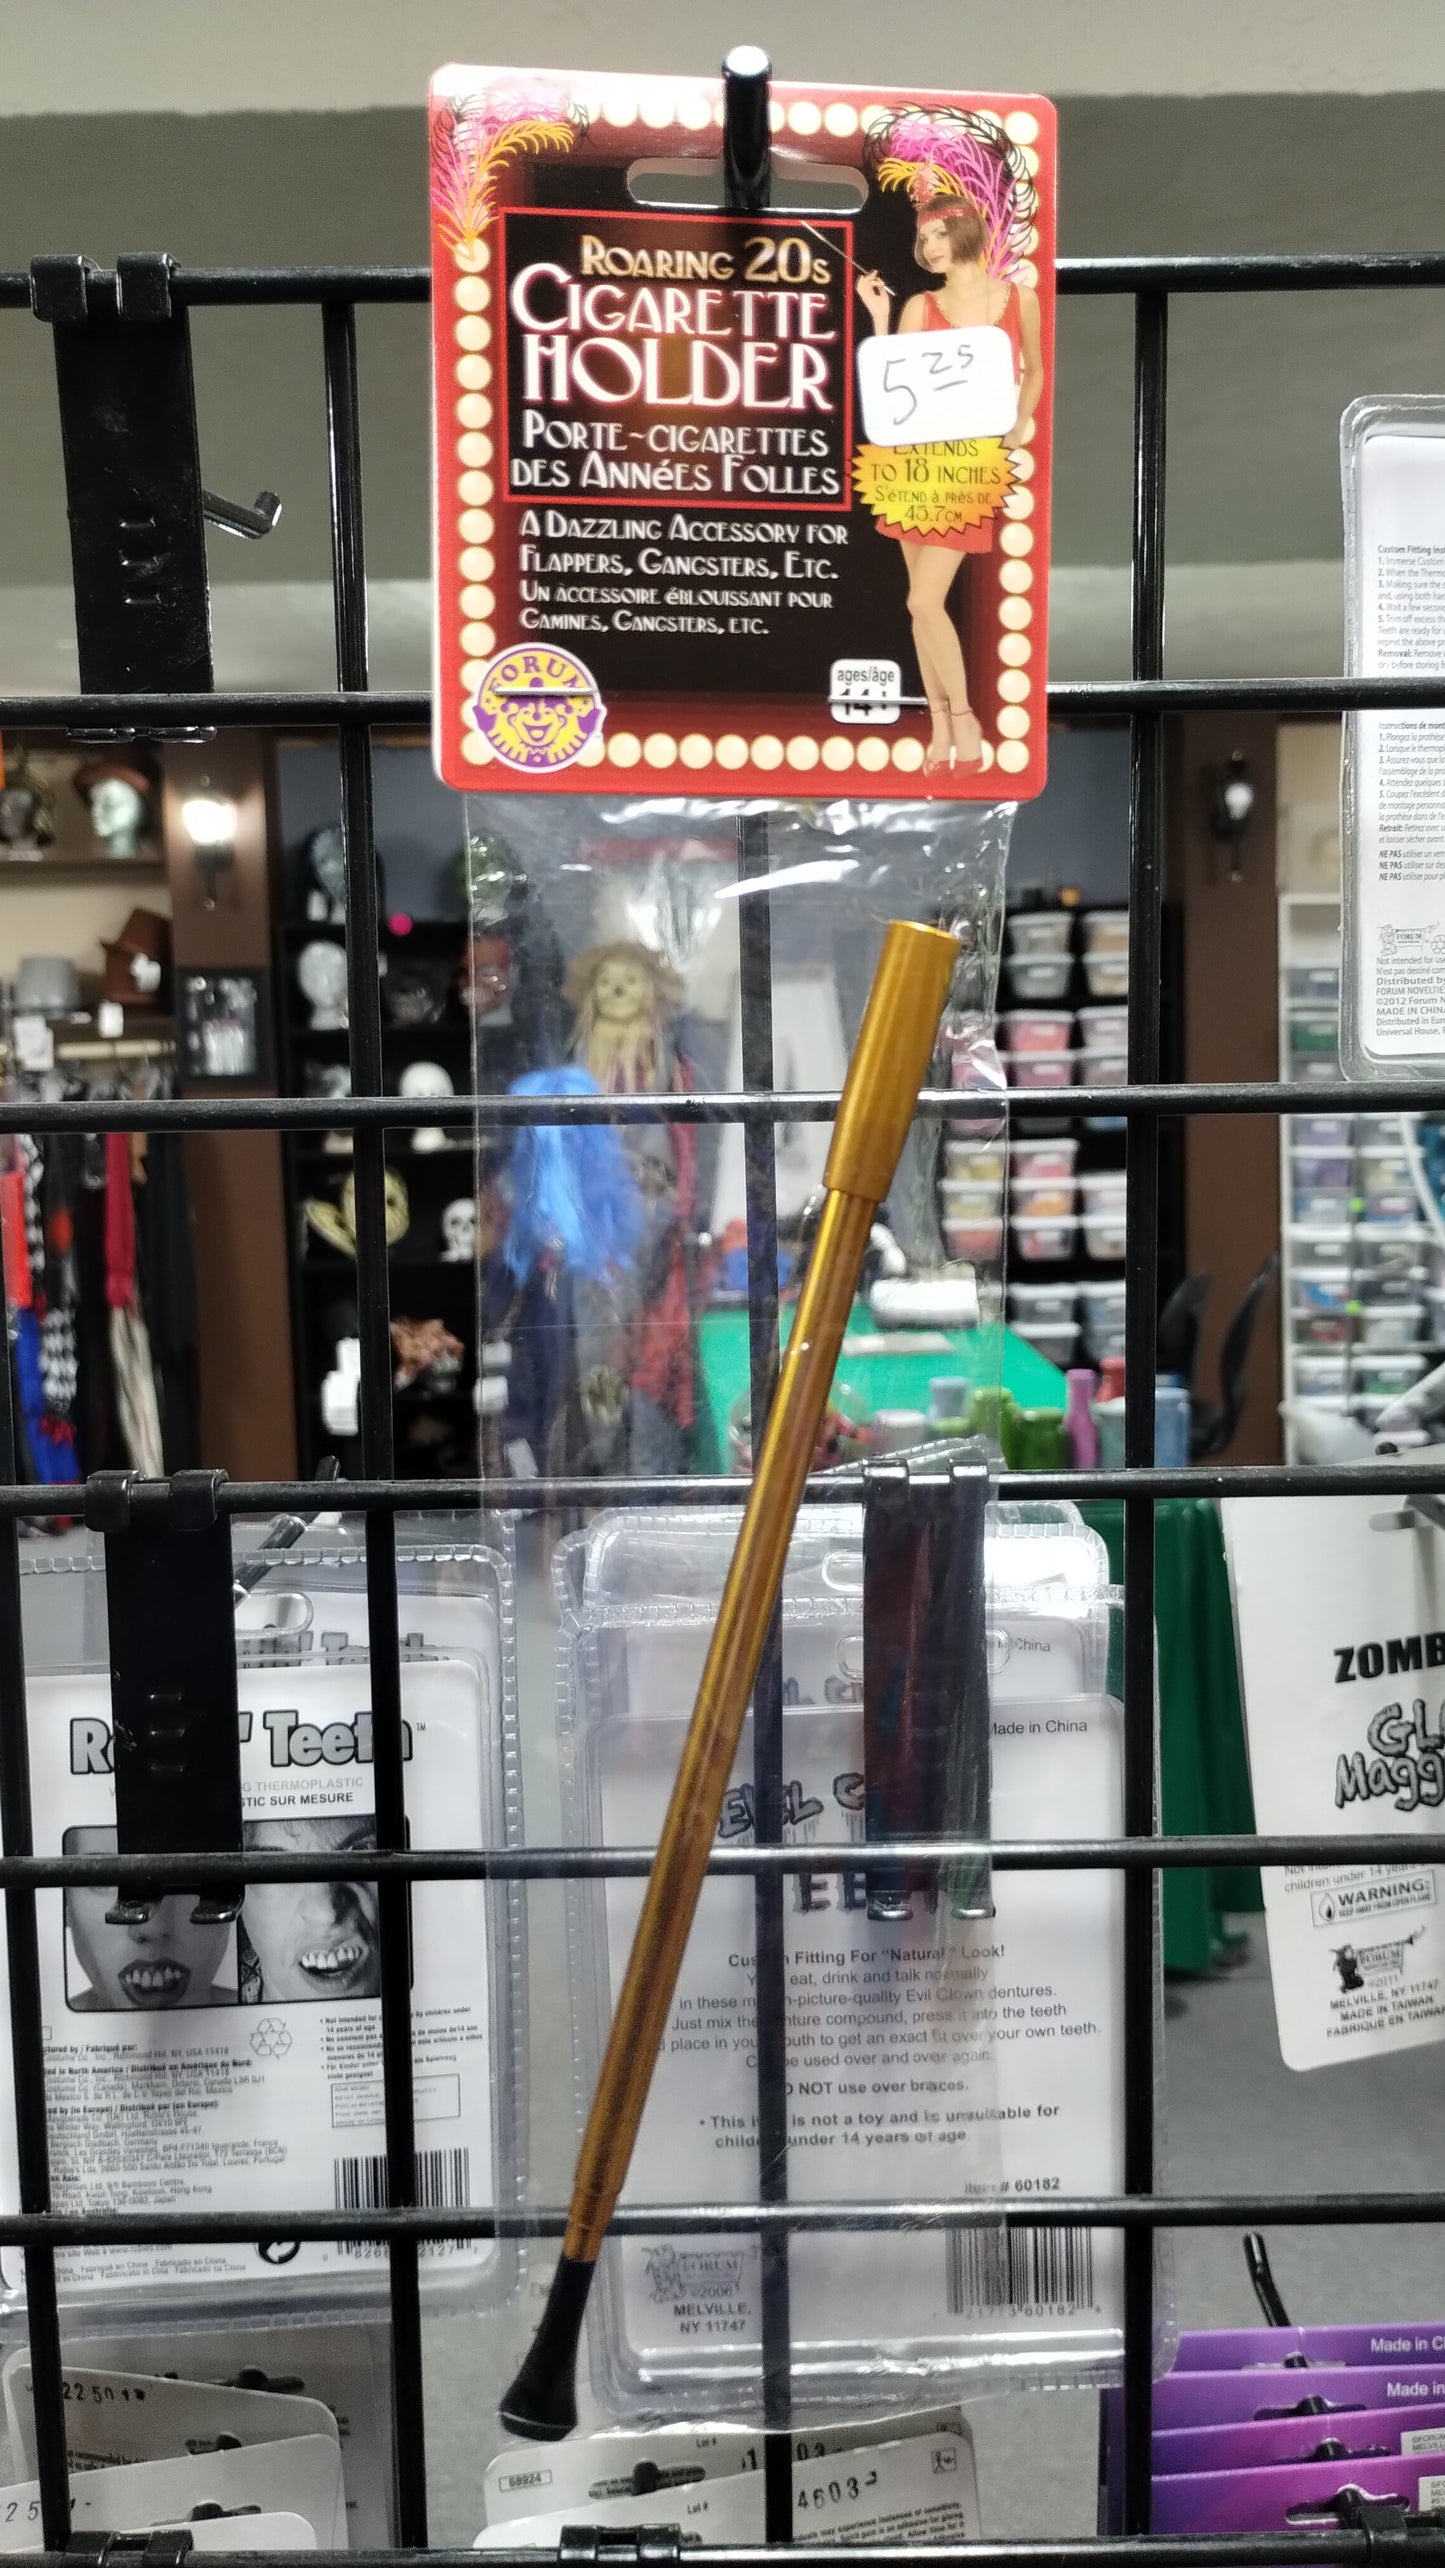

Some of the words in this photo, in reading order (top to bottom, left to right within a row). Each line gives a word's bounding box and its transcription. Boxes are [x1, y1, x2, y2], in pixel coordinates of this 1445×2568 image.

[510, 262, 837, 340] CIGARETTE
[522, 333, 834, 410] HOLDER
[871, 464, 897, 482] TO
[905, 458, 930, 483] 18
[938, 466, 1001, 484] INCHES
[519, 509, 541, 537] A
[1376, 977, 1433, 986] Distributed
[1376, 987, 1405, 996] FORUM
[1376, 1007, 1404, 1016] MADE
[1407, 1006, 1417, 1015] IN
[1029, 1720, 1042, 1734] in
[1045, 1719, 1088, 1733] China
[256, 1776, 364, 1793] THERMOPLASTIC
[270, 1794, 296, 1806] SUR
[300, 1791, 353, 1806] MESURE
[795, 1951, 845, 1965] Fitting
[850, 1950, 876, 1961] For
[962, 1944, 1005, 1959] Look!
[790, 1973, 817, 1986] eat,
[822, 1971, 858, 1983] drink
[863, 1970, 890, 1983] and
[895, 1968, 920, 1981] talk
[680, 1997, 692, 2009] in
[697, 1995, 737, 2008] these
[906, 1988, 931, 2001] Evil
[935, 1986, 983, 2000] Clown
[989, 1984, 1056, 1999] dentures.
[671, 2018, 701, 2030] Just
[706, 2017, 732, 2029] mix
[826, 2010, 908, 2026] compound,
[913, 2010, 953, 2025] press
[958, 2008, 968, 2019] it
[1002, 2006, 1025, 2018] the
[1030, 2003, 1067, 2017] teeth
[670, 2037, 710, 2052] place
[715, 2036, 727, 2048] in
[820, 2034, 834, 2046] to
[838, 2033, 861, 2049] get
[866, 2033, 885, 2045] an
[889, 2030, 928, 2043] exact
[932, 2027, 947, 2042] fit
[952, 2030, 982, 2041] over
[988, 2028, 1021, 2043] your
[1025, 2026, 1055, 2039] own
[1060, 2021, 1101, 2036] teeth.
[804, 2052, 839, 2066] used
[844, 2053, 876, 2065] over
[882, 2050, 909, 2064] and
[912, 2051, 946, 2063] over
[799, 2082, 832, 2095] NOT
[838, 2083, 867, 2094] use
[871, 2081, 905, 2093] over
[909, 2078, 970, 2093] braces.
[710, 2115, 745, 2128] This
[792, 2114, 805, 2127] is
[811, 2113, 839, 2126] not
[844, 2115, 853, 2126] a
[858, 2112, 884, 2128] toy
[889, 2110, 919, 2124] and
[1037, 2104, 1060, 2118] for
[787, 2133, 835, 2146] under
[841, 2131, 859, 2145] 14
[865, 2131, 909, 2147] years
[914, 2130, 934, 2143] of
[1015, 2177, 1060, 2192] 60182
[680, 2321, 700, 2333] NY
[706, 2319, 746, 2332] 11747
[1371, 2338, 1413, 2353] Made
[1415, 2337, 1428, 2351] in
[1387, 2382, 1429, 2397] Made
